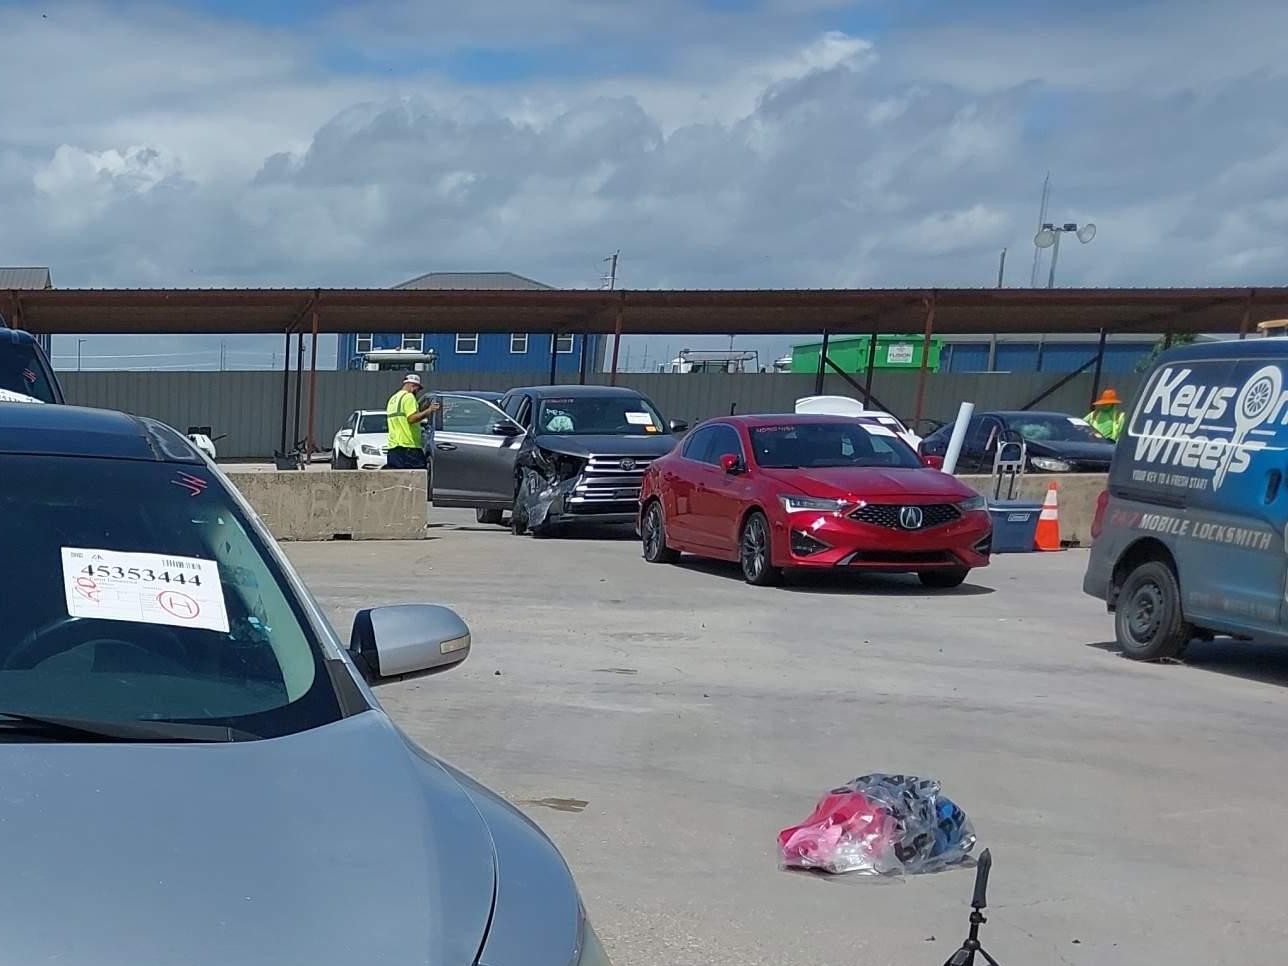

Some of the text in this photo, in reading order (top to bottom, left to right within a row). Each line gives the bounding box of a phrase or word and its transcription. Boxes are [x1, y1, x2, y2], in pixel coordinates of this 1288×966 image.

[1143, 368, 1237, 433] Keys
[1134, 420, 1267, 474] Wheels
[1188, 477, 1209, 489] START
[1138, 513, 1191, 536] MOBILE
[1191, 521, 1273, 550] LOCKSMITH
[80, 563, 203, 587] 45353444
